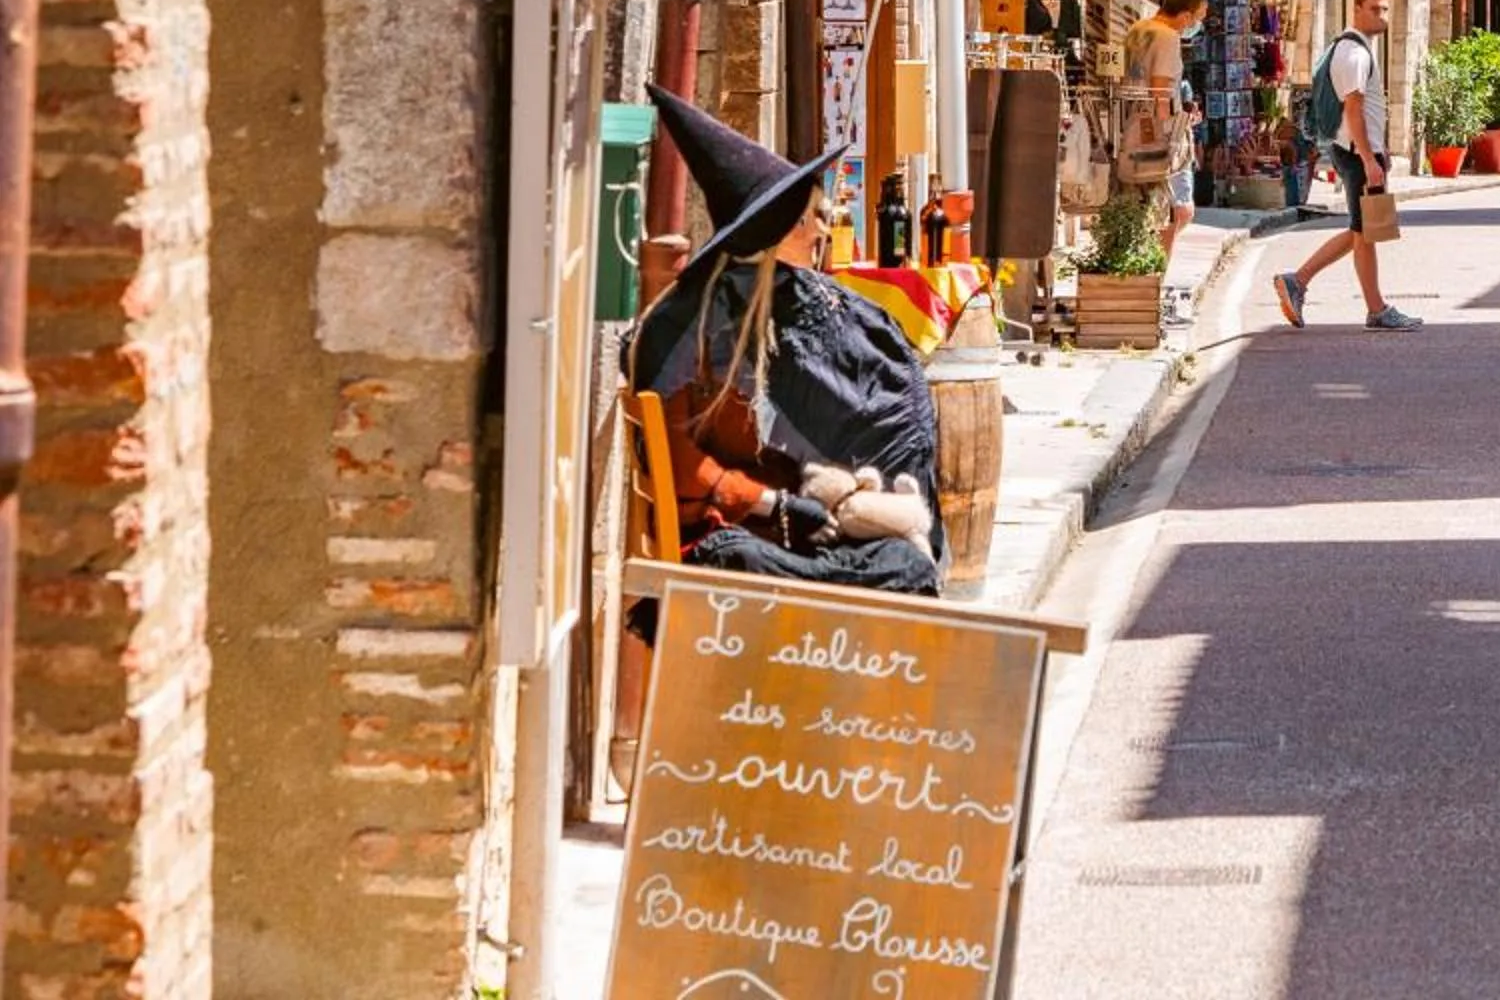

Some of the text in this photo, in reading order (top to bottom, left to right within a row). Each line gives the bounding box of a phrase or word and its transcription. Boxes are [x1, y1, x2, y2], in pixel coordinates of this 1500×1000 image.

[720, 689, 976, 755] des sorcières
[718, 756, 948, 811] ouvert
[642, 808, 973, 889] artisanat local
[635, 874, 822, 964] Boutique
